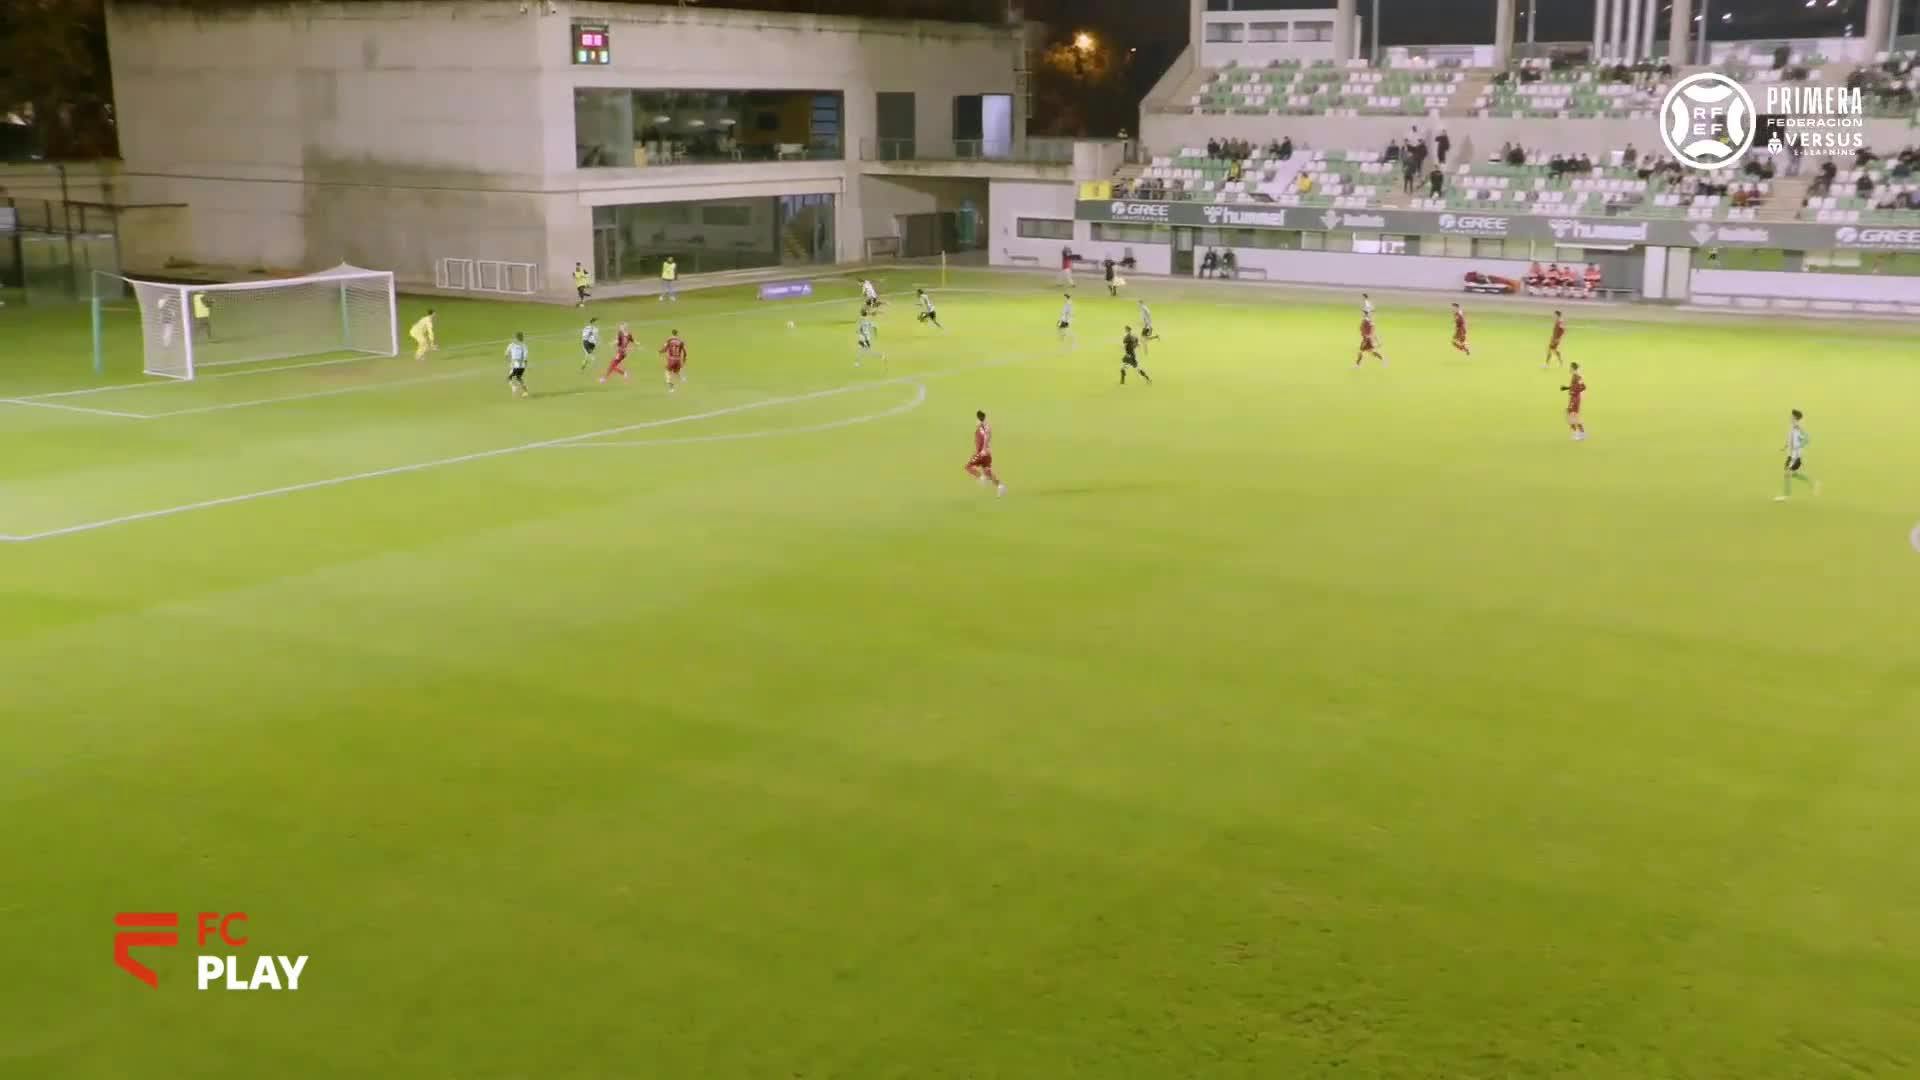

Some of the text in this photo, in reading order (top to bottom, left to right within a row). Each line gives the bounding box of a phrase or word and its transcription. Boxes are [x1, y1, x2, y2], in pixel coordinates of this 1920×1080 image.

[1128, 204, 1169, 216] GREE
[1457, 217, 1509, 230] GREE
[1573, 220, 1648, 241] hul
